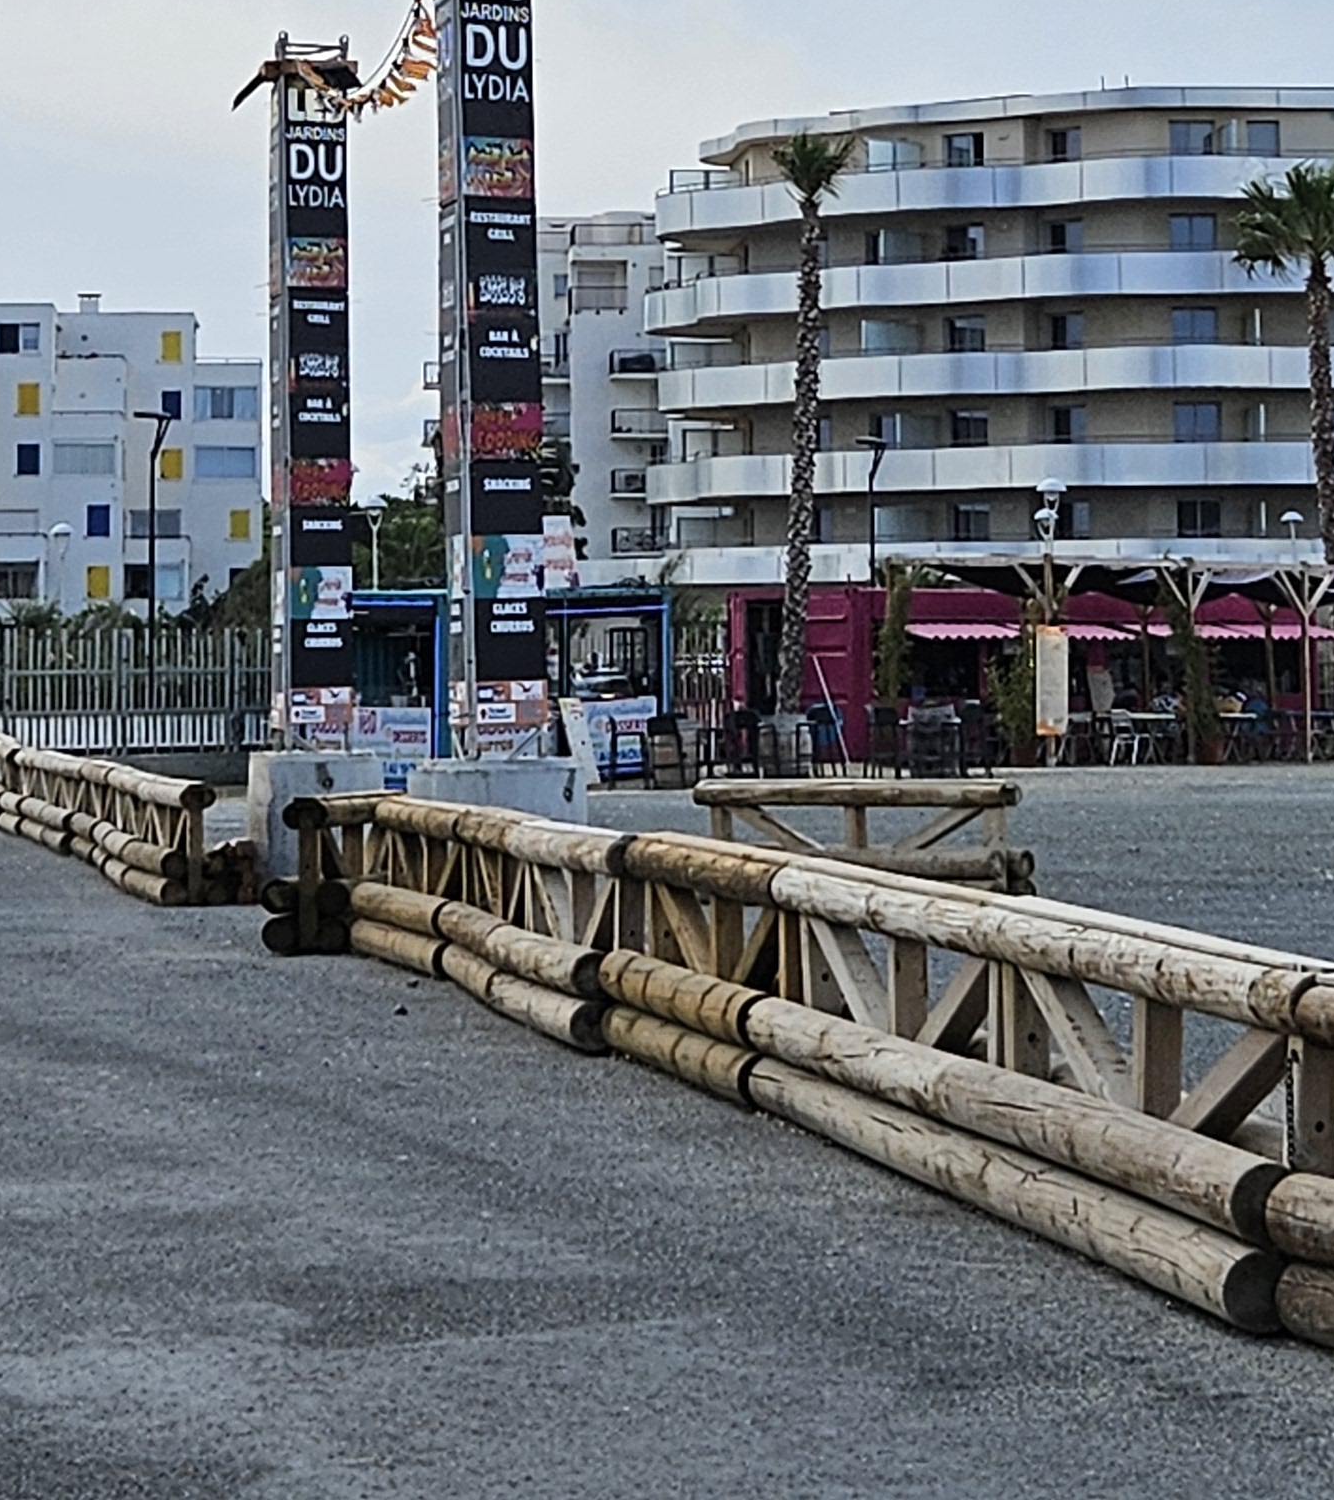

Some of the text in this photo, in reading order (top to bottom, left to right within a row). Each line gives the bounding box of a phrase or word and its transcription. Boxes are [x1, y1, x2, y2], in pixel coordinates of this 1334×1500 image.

[461, 2, 530, 24] JARDINS
[466, 23, 528, 70] DU
[464, 73, 530, 103] LYDIA
[288, 88, 345, 123] LES
[284, 126, 345, 142] JARDINS
[290, 143, 343, 181] DU
[288, 184, 345, 208] LYDIA
[489, 331, 509, 342] BAR
[479, 346, 529, 358] COCKTAILS
